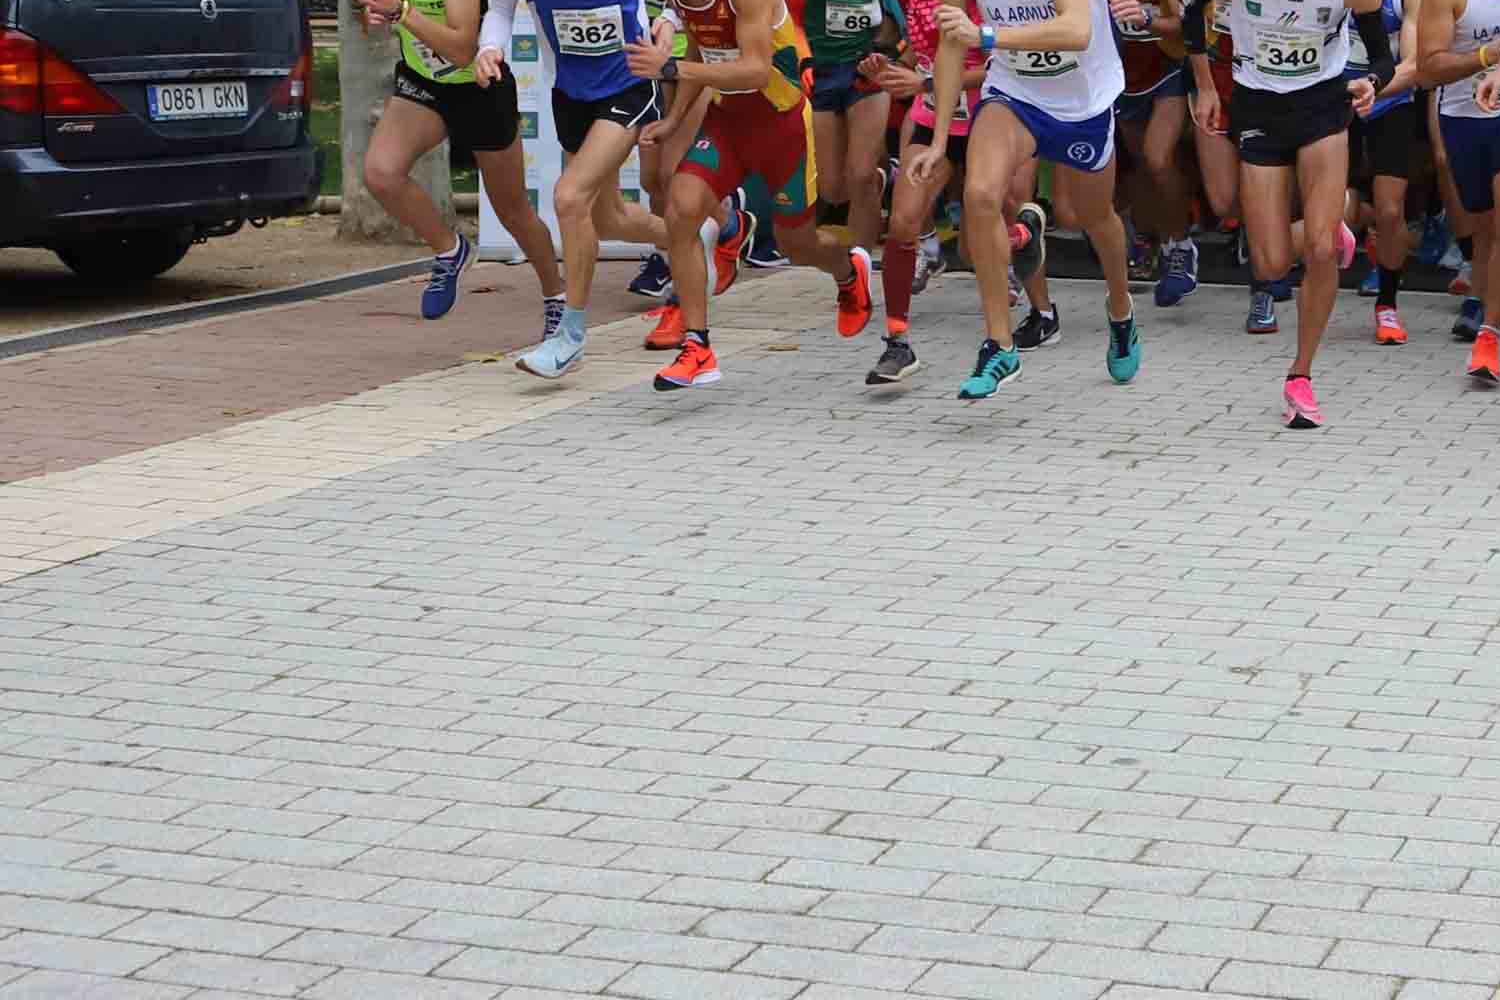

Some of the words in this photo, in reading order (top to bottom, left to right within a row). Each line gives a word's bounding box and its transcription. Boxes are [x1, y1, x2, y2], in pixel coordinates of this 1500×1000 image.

[986, 7, 1004, 22] LA
[1008, 1, 1057, 22] ARMUÑ
[569, 22, 618, 44] 362
[1474, 28, 1488, 40] LA
[1026, 51, 1062, 69] 26
[1268, 47, 1318, 67] 340
[161, 87, 205, 112] 0861
[213, 85, 246, 109] GKN
